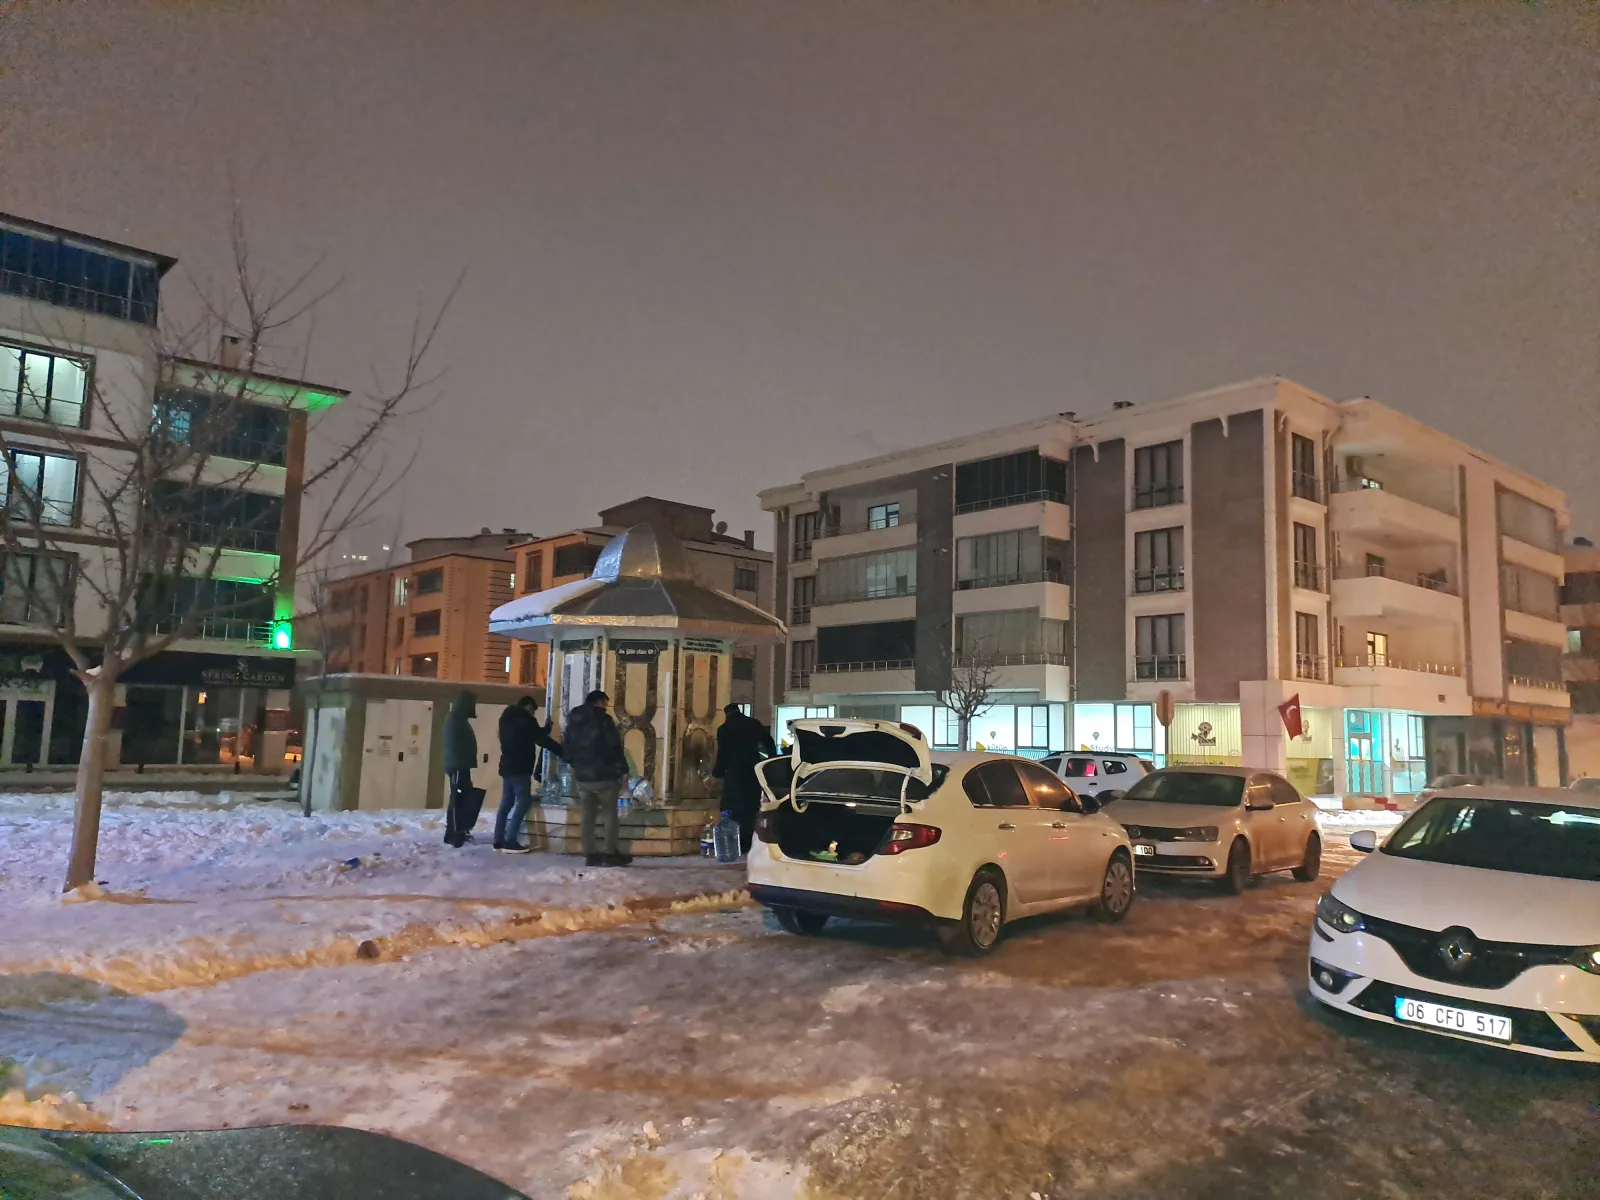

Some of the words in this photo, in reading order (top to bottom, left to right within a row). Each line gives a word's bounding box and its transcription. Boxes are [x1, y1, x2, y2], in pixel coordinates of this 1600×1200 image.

[201, 670, 240, 681] SPRING
[242, 672, 286, 682] GARDEN
[1406, 1002, 1424, 1020] 06
[1436, 1008, 1465, 1028] CFD
[1476, 1015, 1507, 1036] 517
